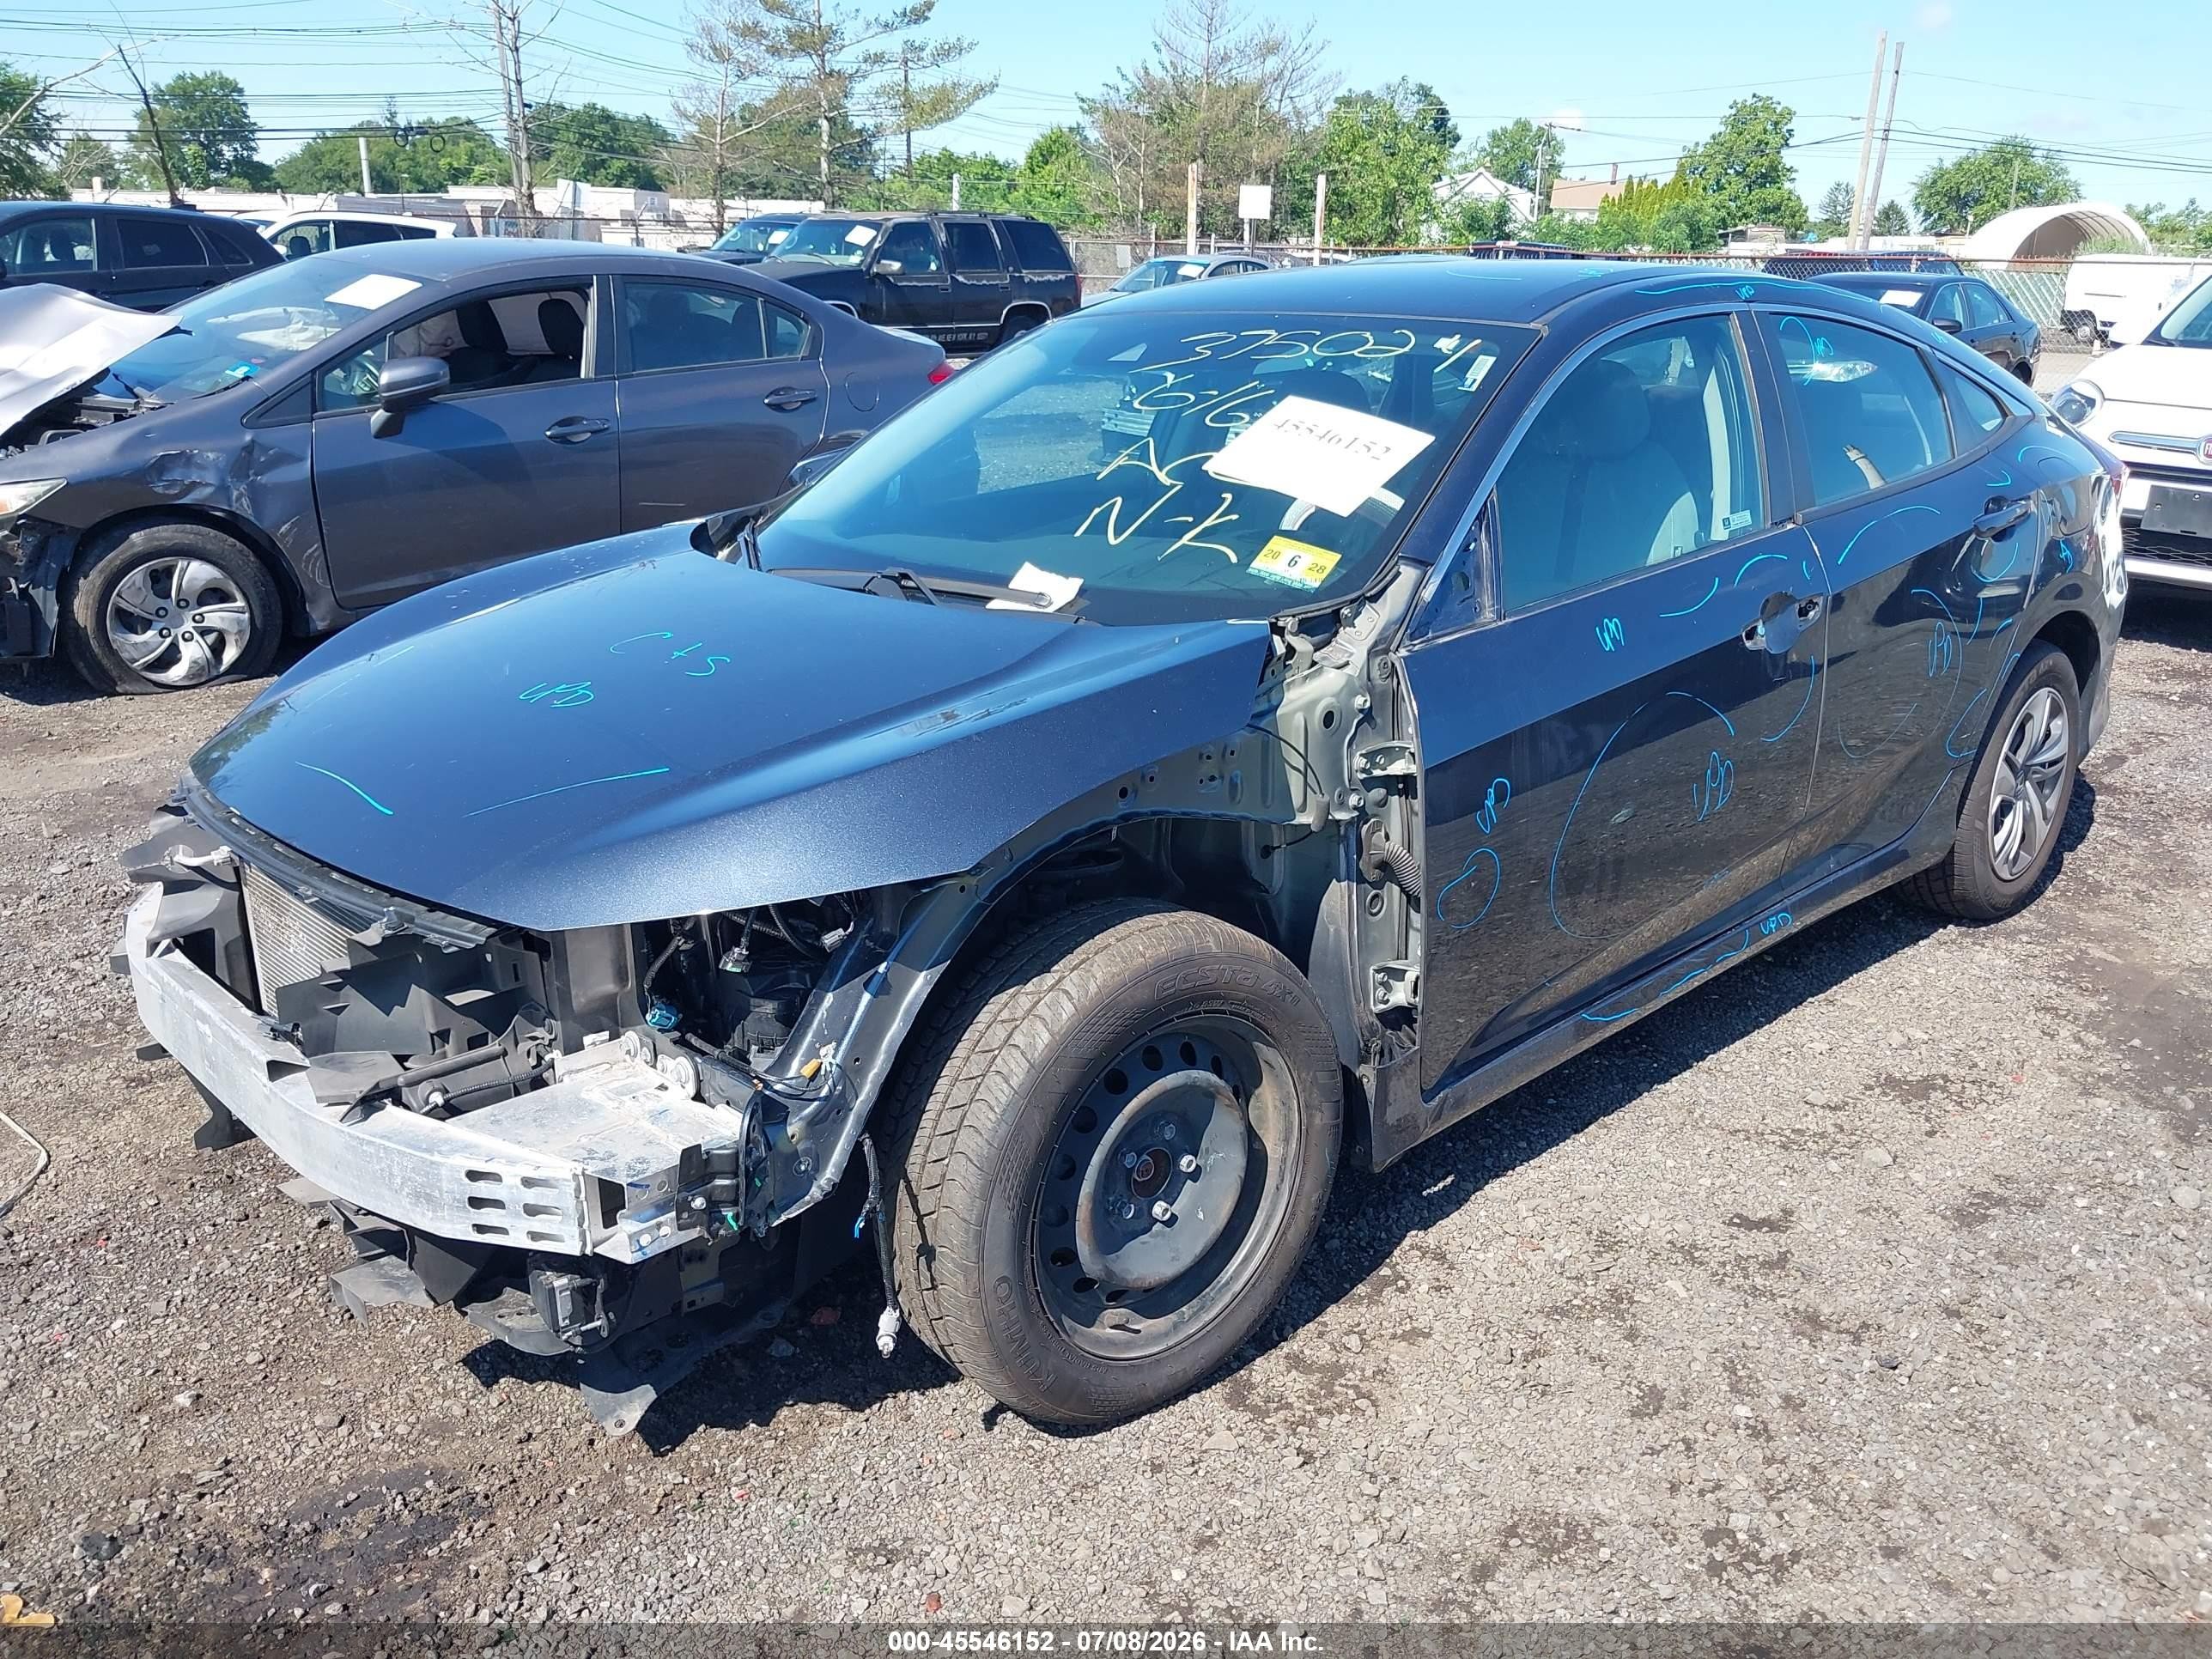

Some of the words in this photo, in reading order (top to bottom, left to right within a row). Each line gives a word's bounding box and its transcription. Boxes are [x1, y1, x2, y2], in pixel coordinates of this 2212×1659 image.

[1273, 418, 1392, 460] 45546152
[1263, 549, 1281, 561] 20
[1287, 554, 1302, 568] 6
[1307, 562, 1327, 574] 28
[1759, 912, 1792, 935] UPD
[993, 1273, 1059, 1393] KUMHO
